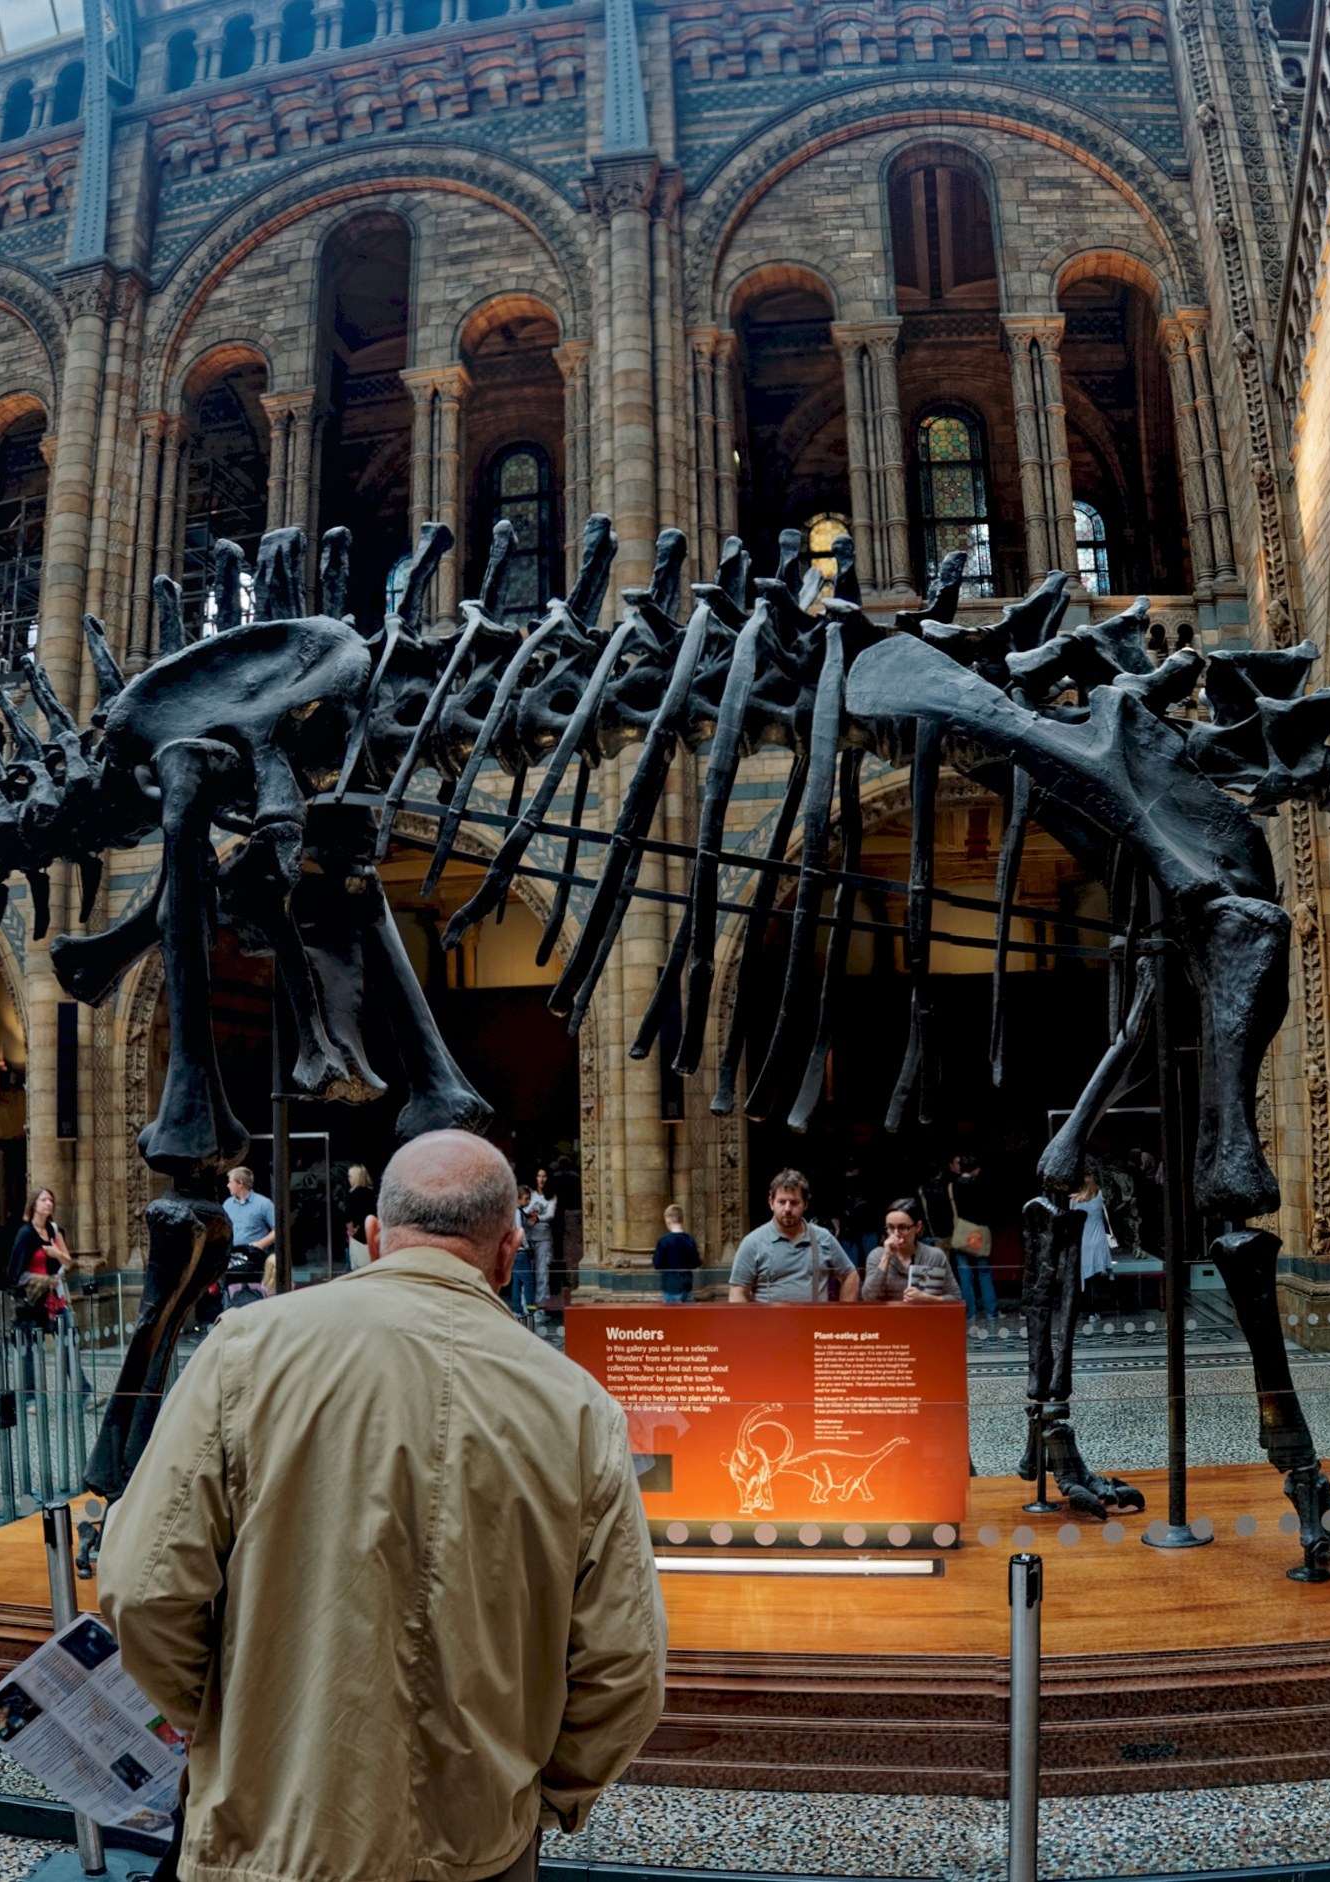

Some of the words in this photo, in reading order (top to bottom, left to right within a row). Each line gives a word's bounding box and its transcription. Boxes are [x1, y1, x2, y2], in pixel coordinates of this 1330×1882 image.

[606, 1326, 664, 1340] Wonders
[814, 1332, 858, 1341] Plant-eating
[860, 1331, 880, 1341] giant
[606, 1344, 612, 1352] In
[614, 1344, 625, 1352] this
[626, 1345, 646, 1353] gallery
[661, 1344, 670, 1352] will
[607, 1364, 642, 1372] collections.
[642, 1364, 654, 1372] You
[607, 1374, 624, 1382] these
[656, 1375, 664, 1383] by
[665, 1375, 682, 1383] using
[665, 1385, 687, 1393] system
[712, 1385, 726, 1393] bay.
[627, 1394, 638, 1402] will
[638, 1394, 652, 1402] also
[652, 1394, 666, 1402] help
[680, 1394, 687, 1402] to
[702, 1394, 718, 1402] what
[633, 1403, 641, 1411] do
[642, 1402, 662, 1412] during
[663, 1405, 678, 1413] your
[678, 1404, 692, 1412] visit
[692, 1404, 711, 1413] today.
